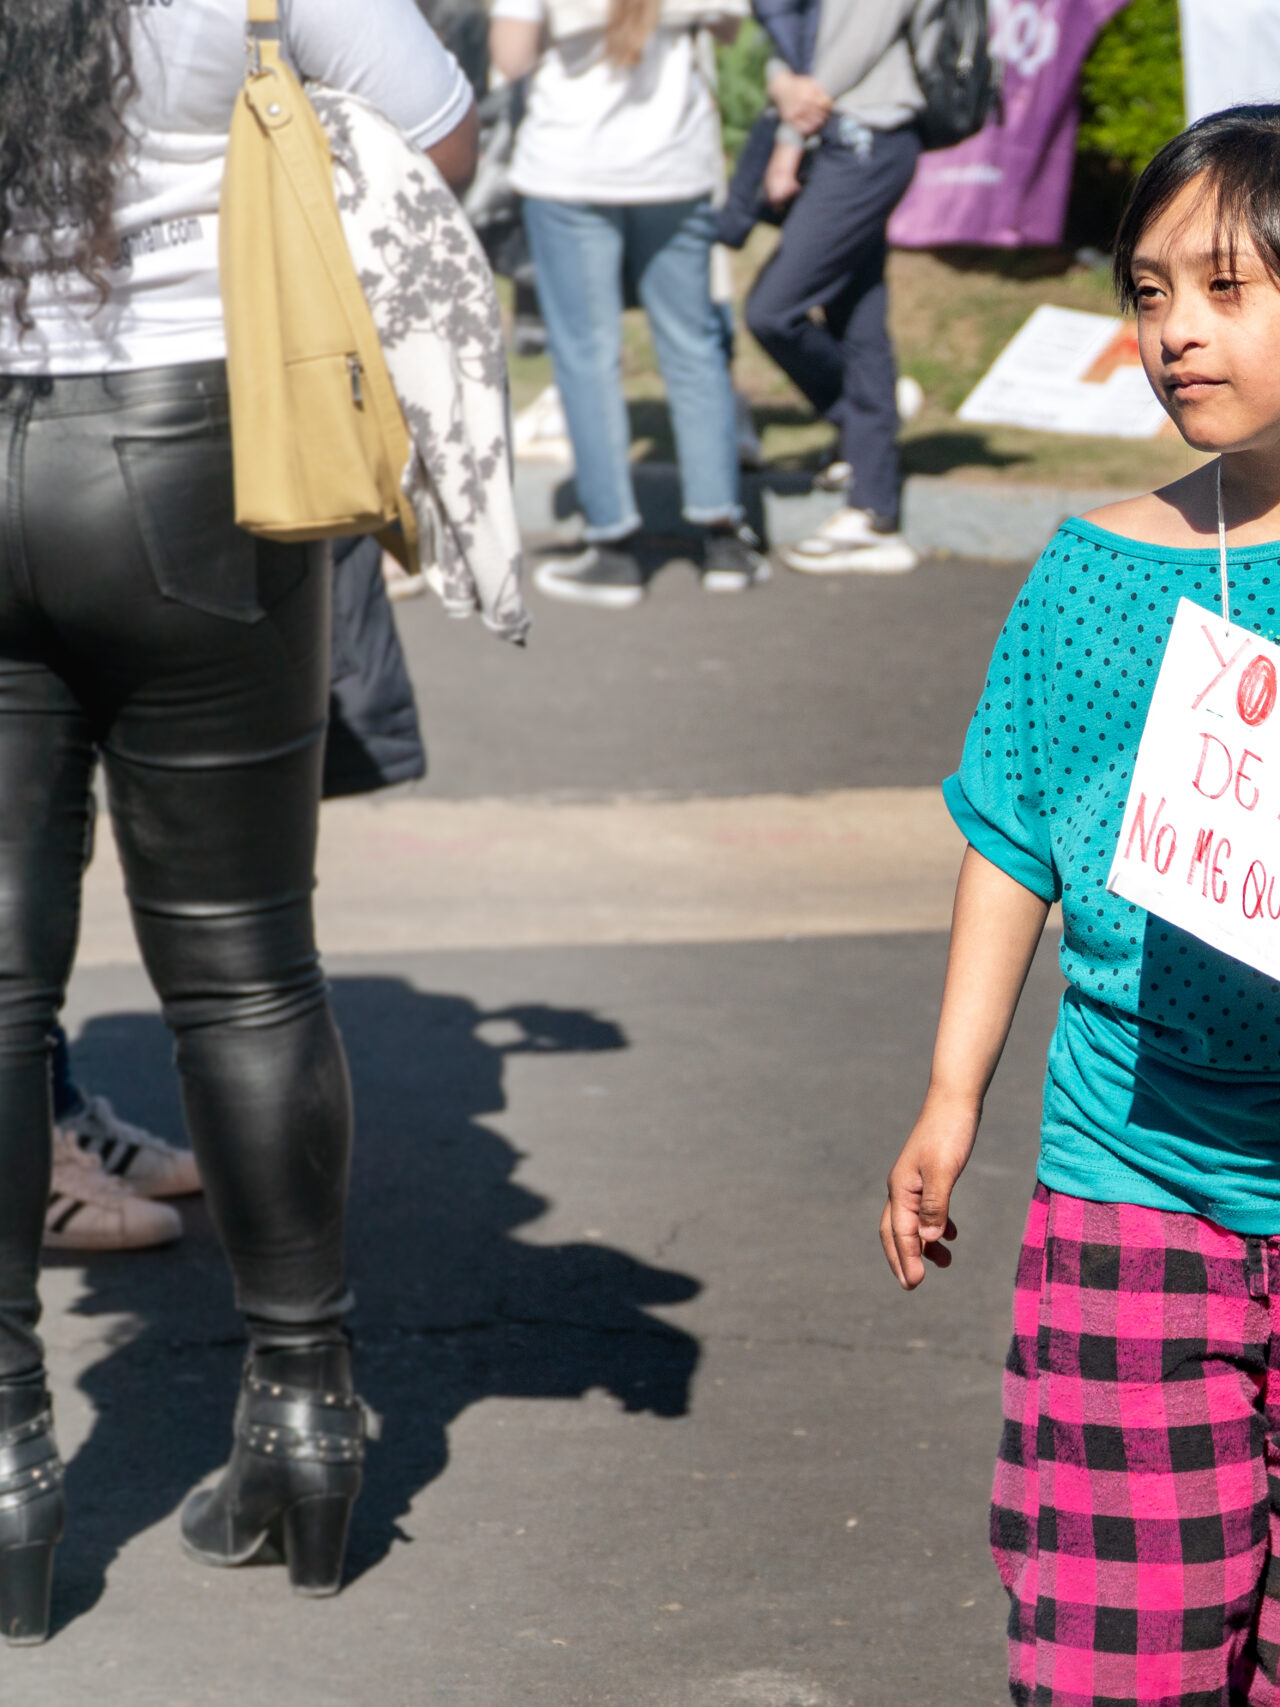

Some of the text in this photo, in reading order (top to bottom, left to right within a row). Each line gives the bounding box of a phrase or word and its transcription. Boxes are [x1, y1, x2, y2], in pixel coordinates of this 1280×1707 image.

[1191, 624, 1278, 727] YO
[1192, 731, 1265, 811] DE
[1123, 791, 1178, 876] NO
[1187, 827, 1232, 904] ME
